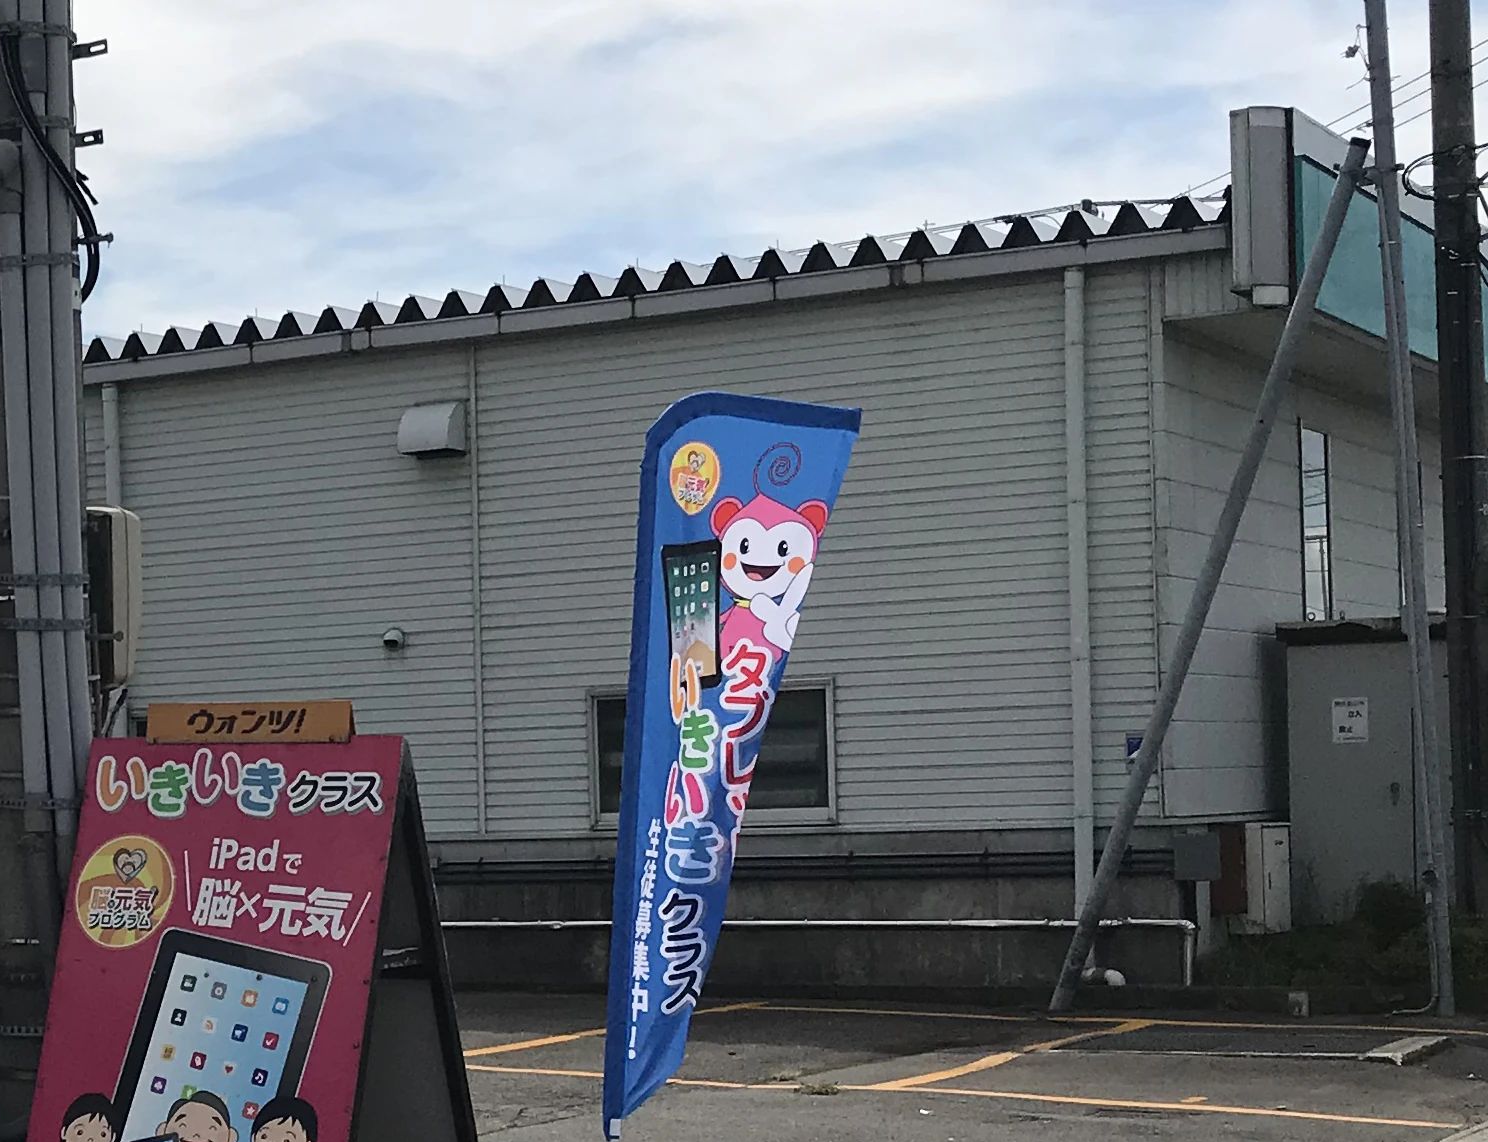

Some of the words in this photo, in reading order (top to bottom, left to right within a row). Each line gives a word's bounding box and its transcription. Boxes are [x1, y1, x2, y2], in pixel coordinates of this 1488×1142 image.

[186, 708, 307, 735] ウォンツ!
[89, 911, 152, 928] プログラム
